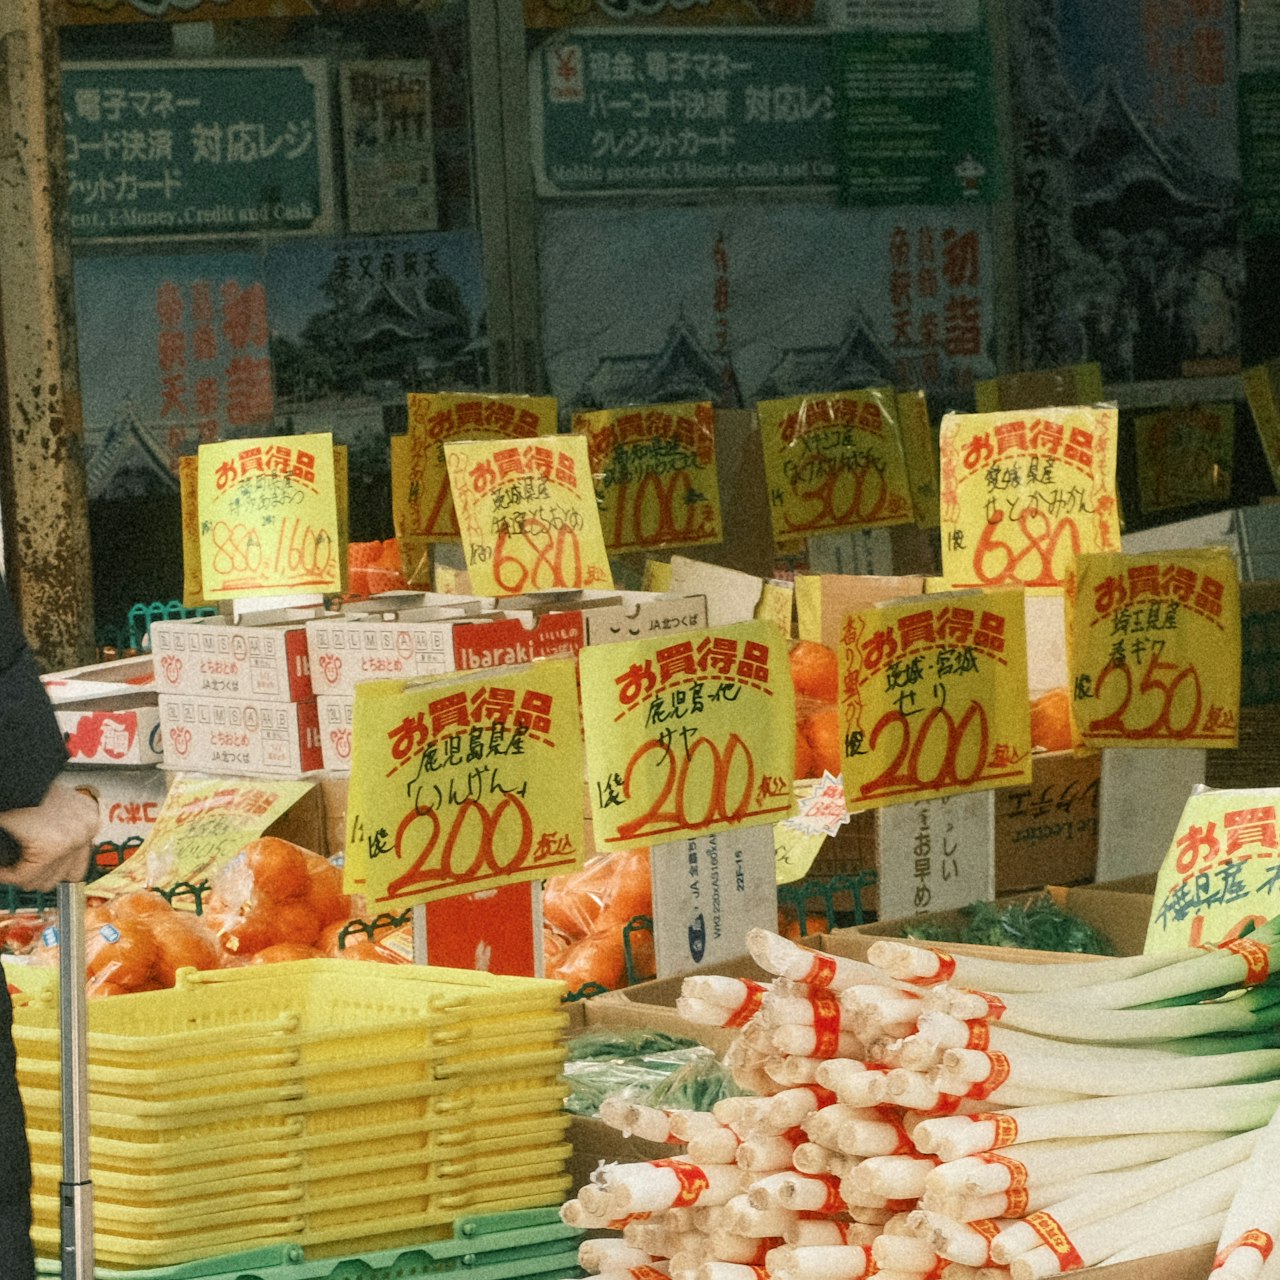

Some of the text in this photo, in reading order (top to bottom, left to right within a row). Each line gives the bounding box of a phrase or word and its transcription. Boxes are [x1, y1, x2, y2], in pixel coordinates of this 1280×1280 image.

[427, 401, 540, 439] お買得品
[962, 418, 1094, 470] お買得品
[215, 444, 316, 490] お買得品
[469, 445, 577, 494] お買得品
[493, 517, 582, 594] 680
[1093, 564, 1225, 618] お買得品
[648, 614, 699, 631] JA北つくば
[861, 606, 1006, 670] お買得品
[360, 656, 403, 673] とちおとめ
[461, 642, 534, 670] Ibaraki
[614, 635, 770, 705] お買得品
[893, 681, 947, 717] せり
[1088, 652, 1203, 741] 250
[209, 731, 251, 748] とちおとめ
[387, 686, 553, 760] お買得品
[656, 725, 699, 767] サヤ
[859, 700, 990, 796] 200
[616, 732, 755, 835] 200
[387, 792, 533, 898] 200
